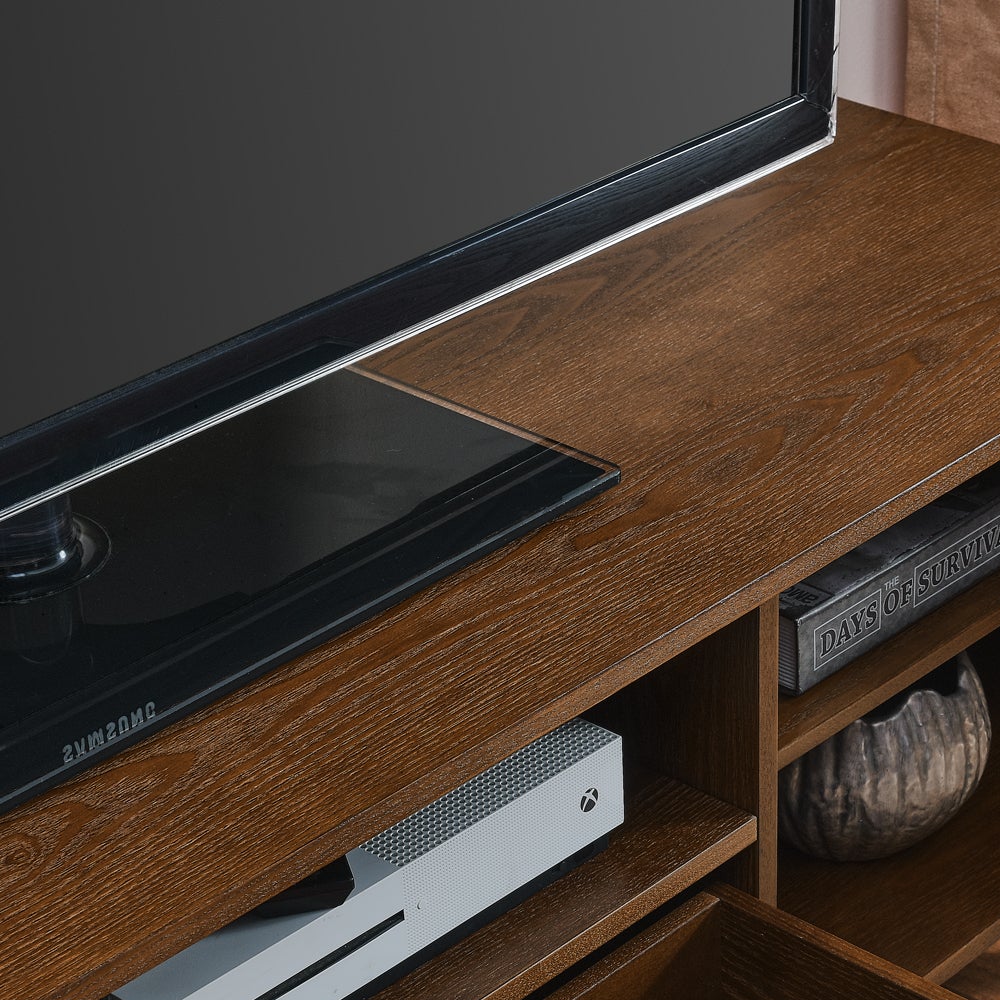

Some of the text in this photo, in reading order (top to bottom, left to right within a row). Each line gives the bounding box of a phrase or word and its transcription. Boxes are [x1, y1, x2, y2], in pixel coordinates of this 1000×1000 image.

[884, 575, 901, 591] THE
[819, 600, 878, 658] DAYS
[883, 578, 914, 616] OF
